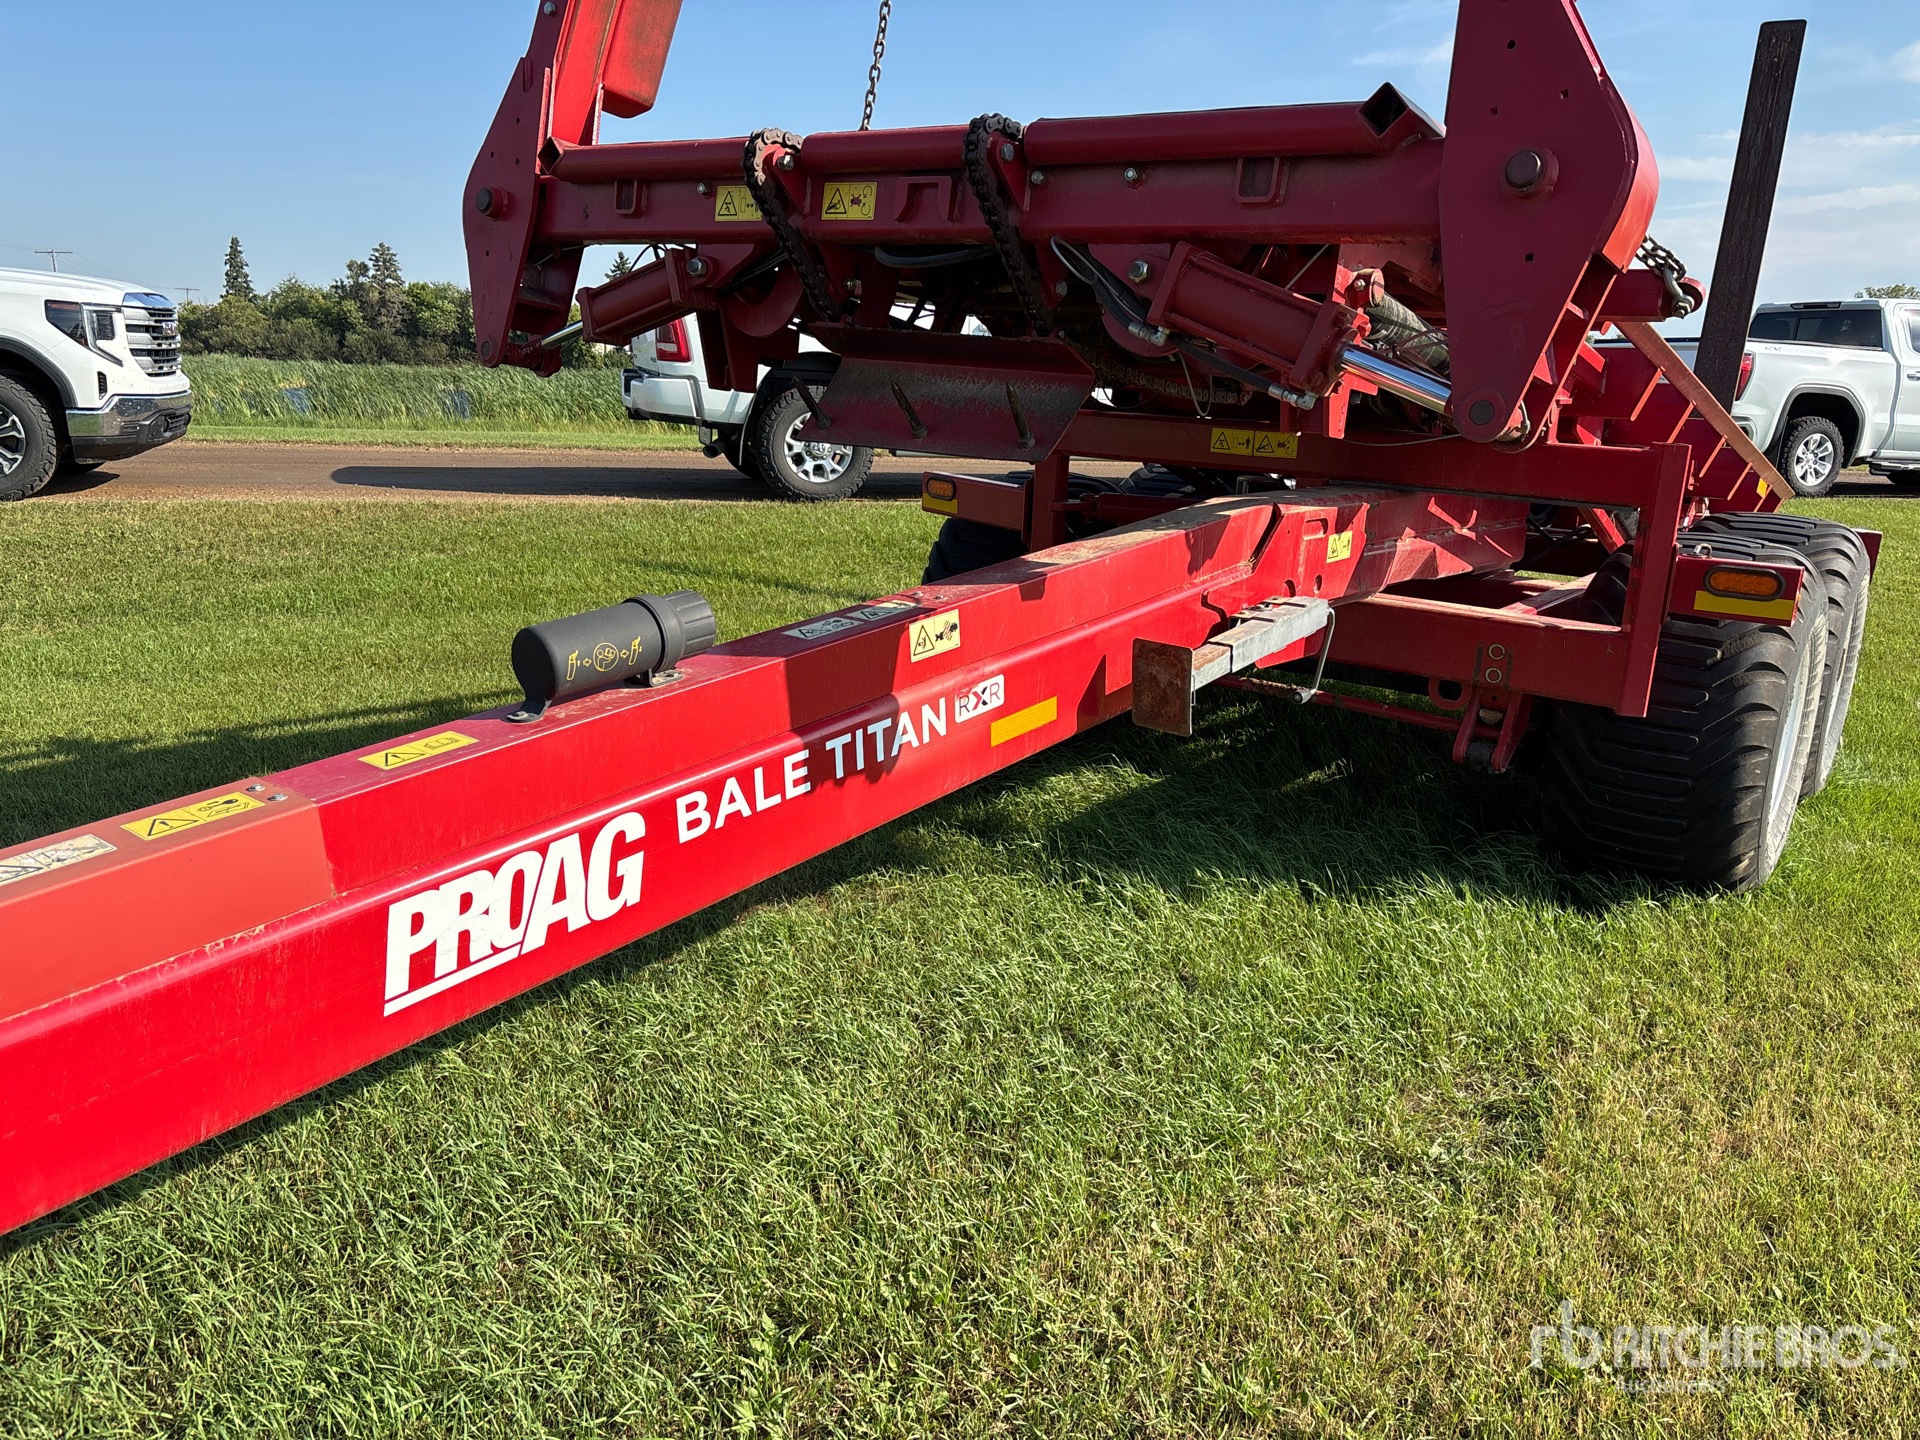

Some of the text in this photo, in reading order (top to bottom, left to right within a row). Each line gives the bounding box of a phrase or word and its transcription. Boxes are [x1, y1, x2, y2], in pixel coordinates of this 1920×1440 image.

[384, 682, 1001, 1001] PROAG BALE TITAN RXR
